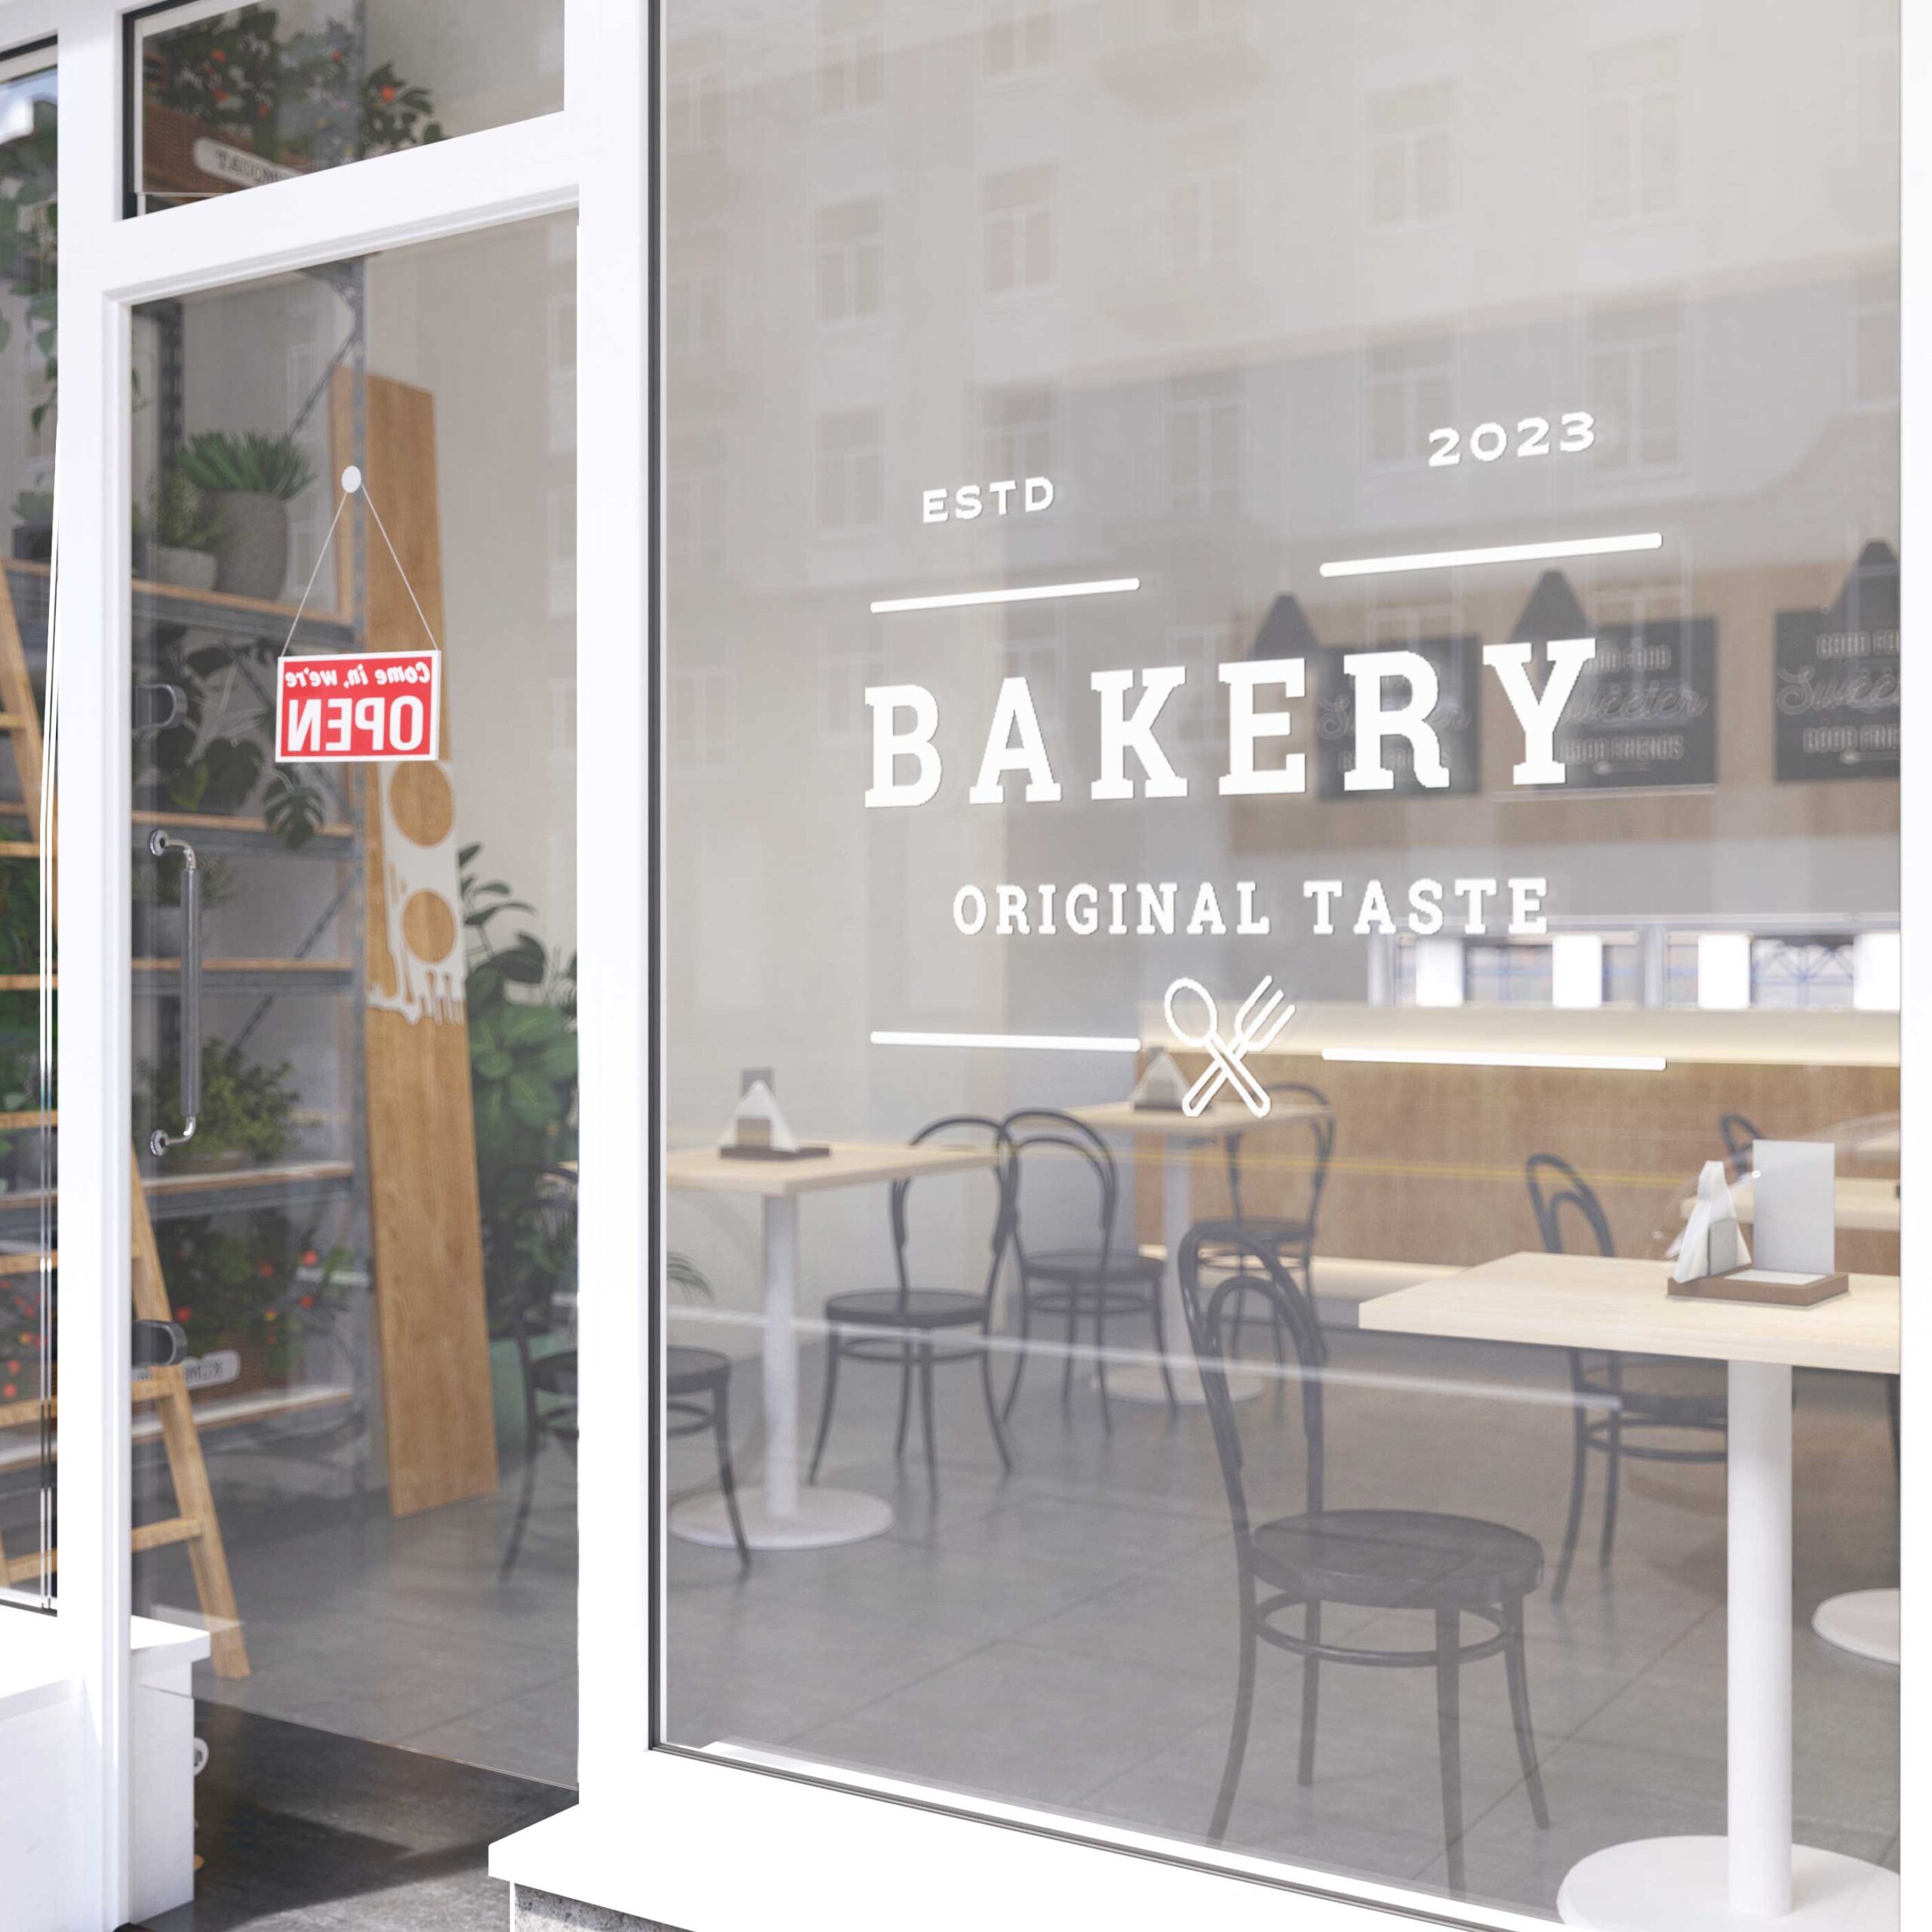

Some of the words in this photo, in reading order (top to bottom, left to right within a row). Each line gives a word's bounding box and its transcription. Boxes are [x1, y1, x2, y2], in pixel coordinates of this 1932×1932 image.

[922, 476, 1056, 523] ESTD
[1428, 411, 1595, 468] 2023
[864, 638, 1596, 808] BAKERY
[952, 882, 1271, 935] ORIGINAL
[1303, 878, 1548, 935] TASTE
